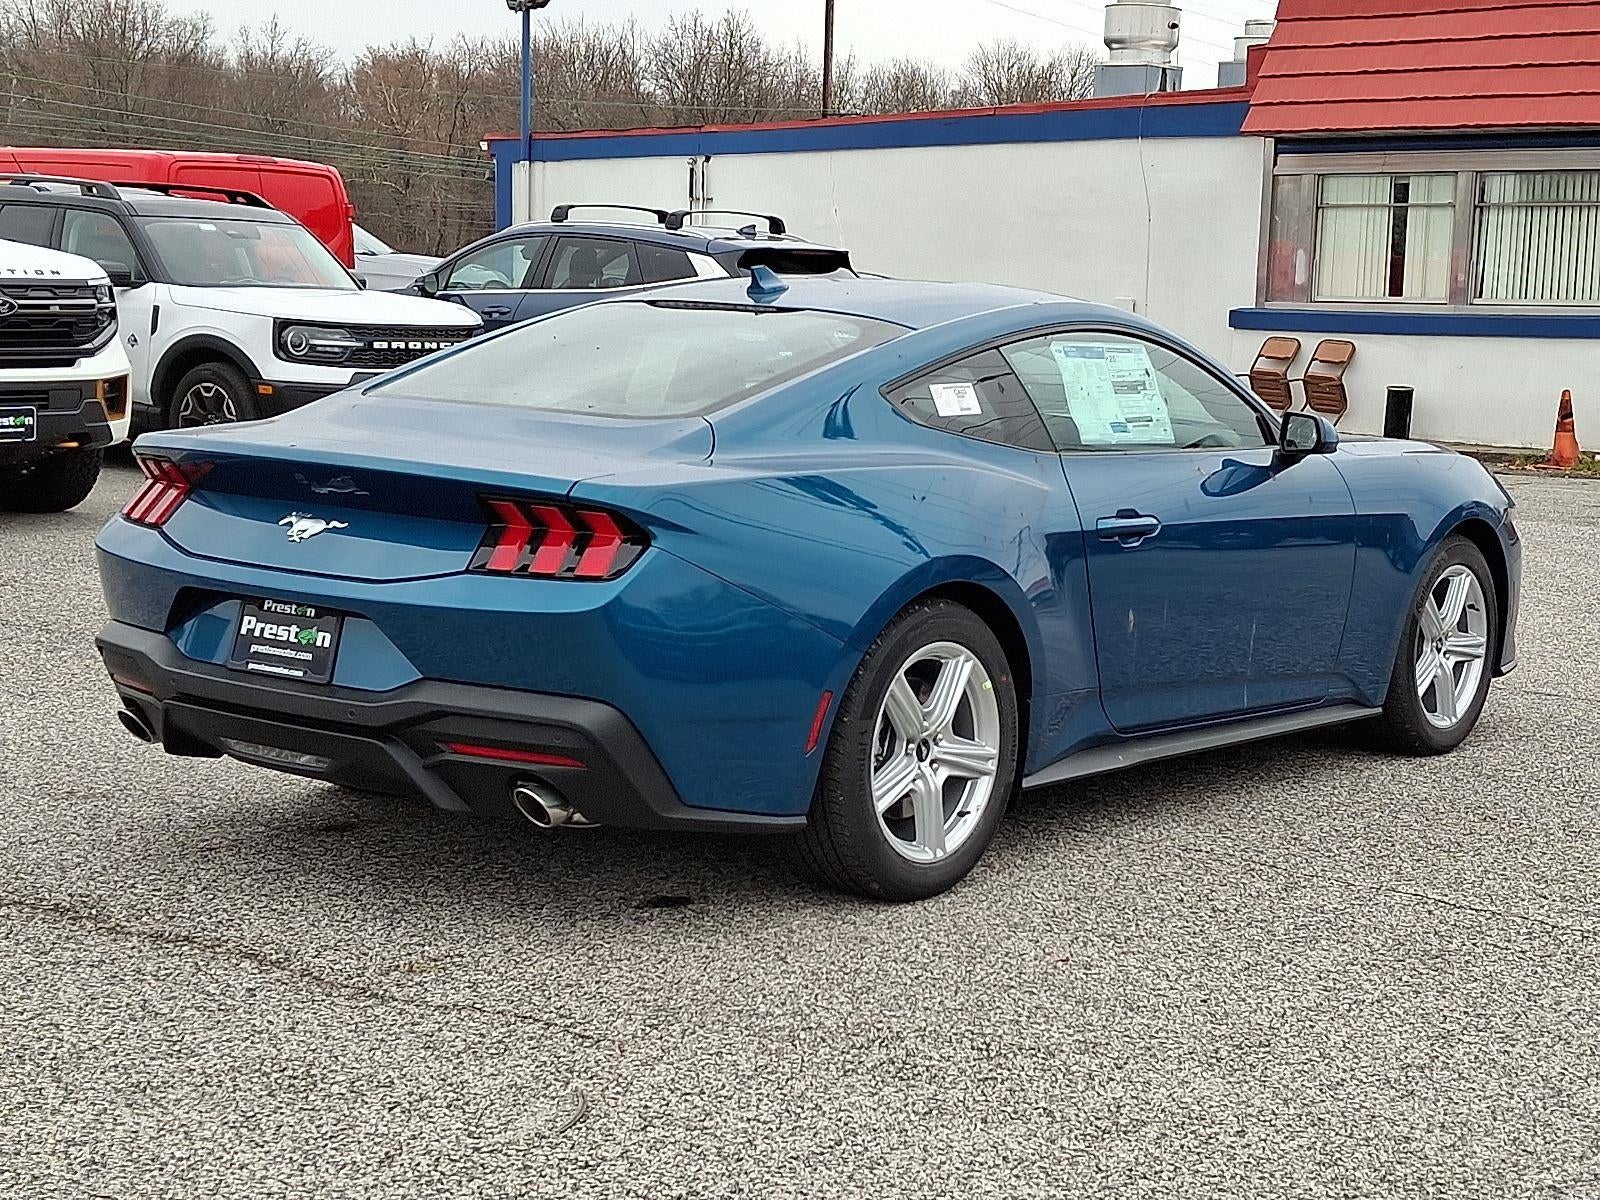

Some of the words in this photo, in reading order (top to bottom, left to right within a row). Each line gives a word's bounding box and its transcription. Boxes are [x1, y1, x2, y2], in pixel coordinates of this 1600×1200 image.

[0, 268, 61, 276] TION
[263, 599, 315, 617] Preston
[240, 615, 331, 647] Preston
